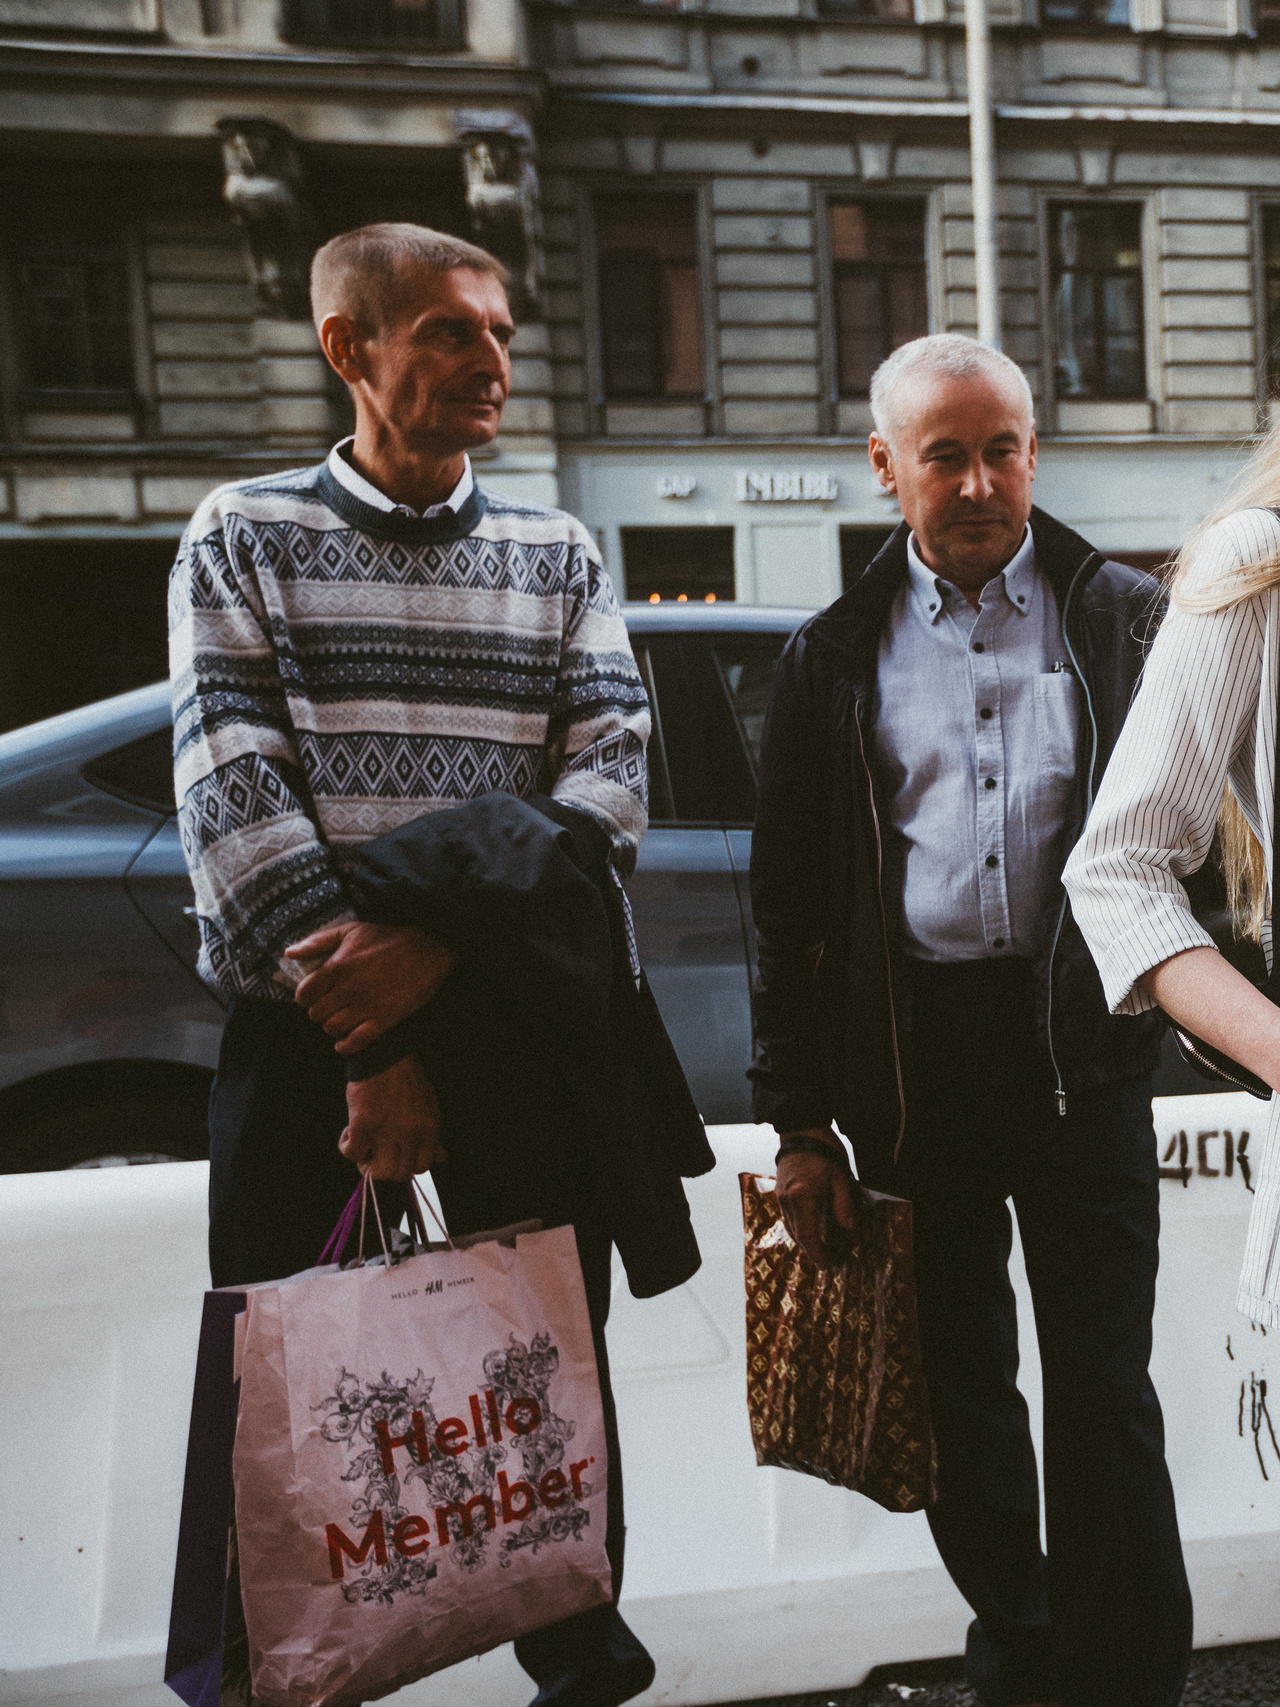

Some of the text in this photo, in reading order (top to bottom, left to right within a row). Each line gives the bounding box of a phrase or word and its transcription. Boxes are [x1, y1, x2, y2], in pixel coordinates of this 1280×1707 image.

[735, 470, 839, 501] IMBIBE
[391, 1276, 475, 1300] HELLO H&M MEMBER
[375, 1388, 542, 1476] Hello
[325, 1457, 595, 1579] Member
